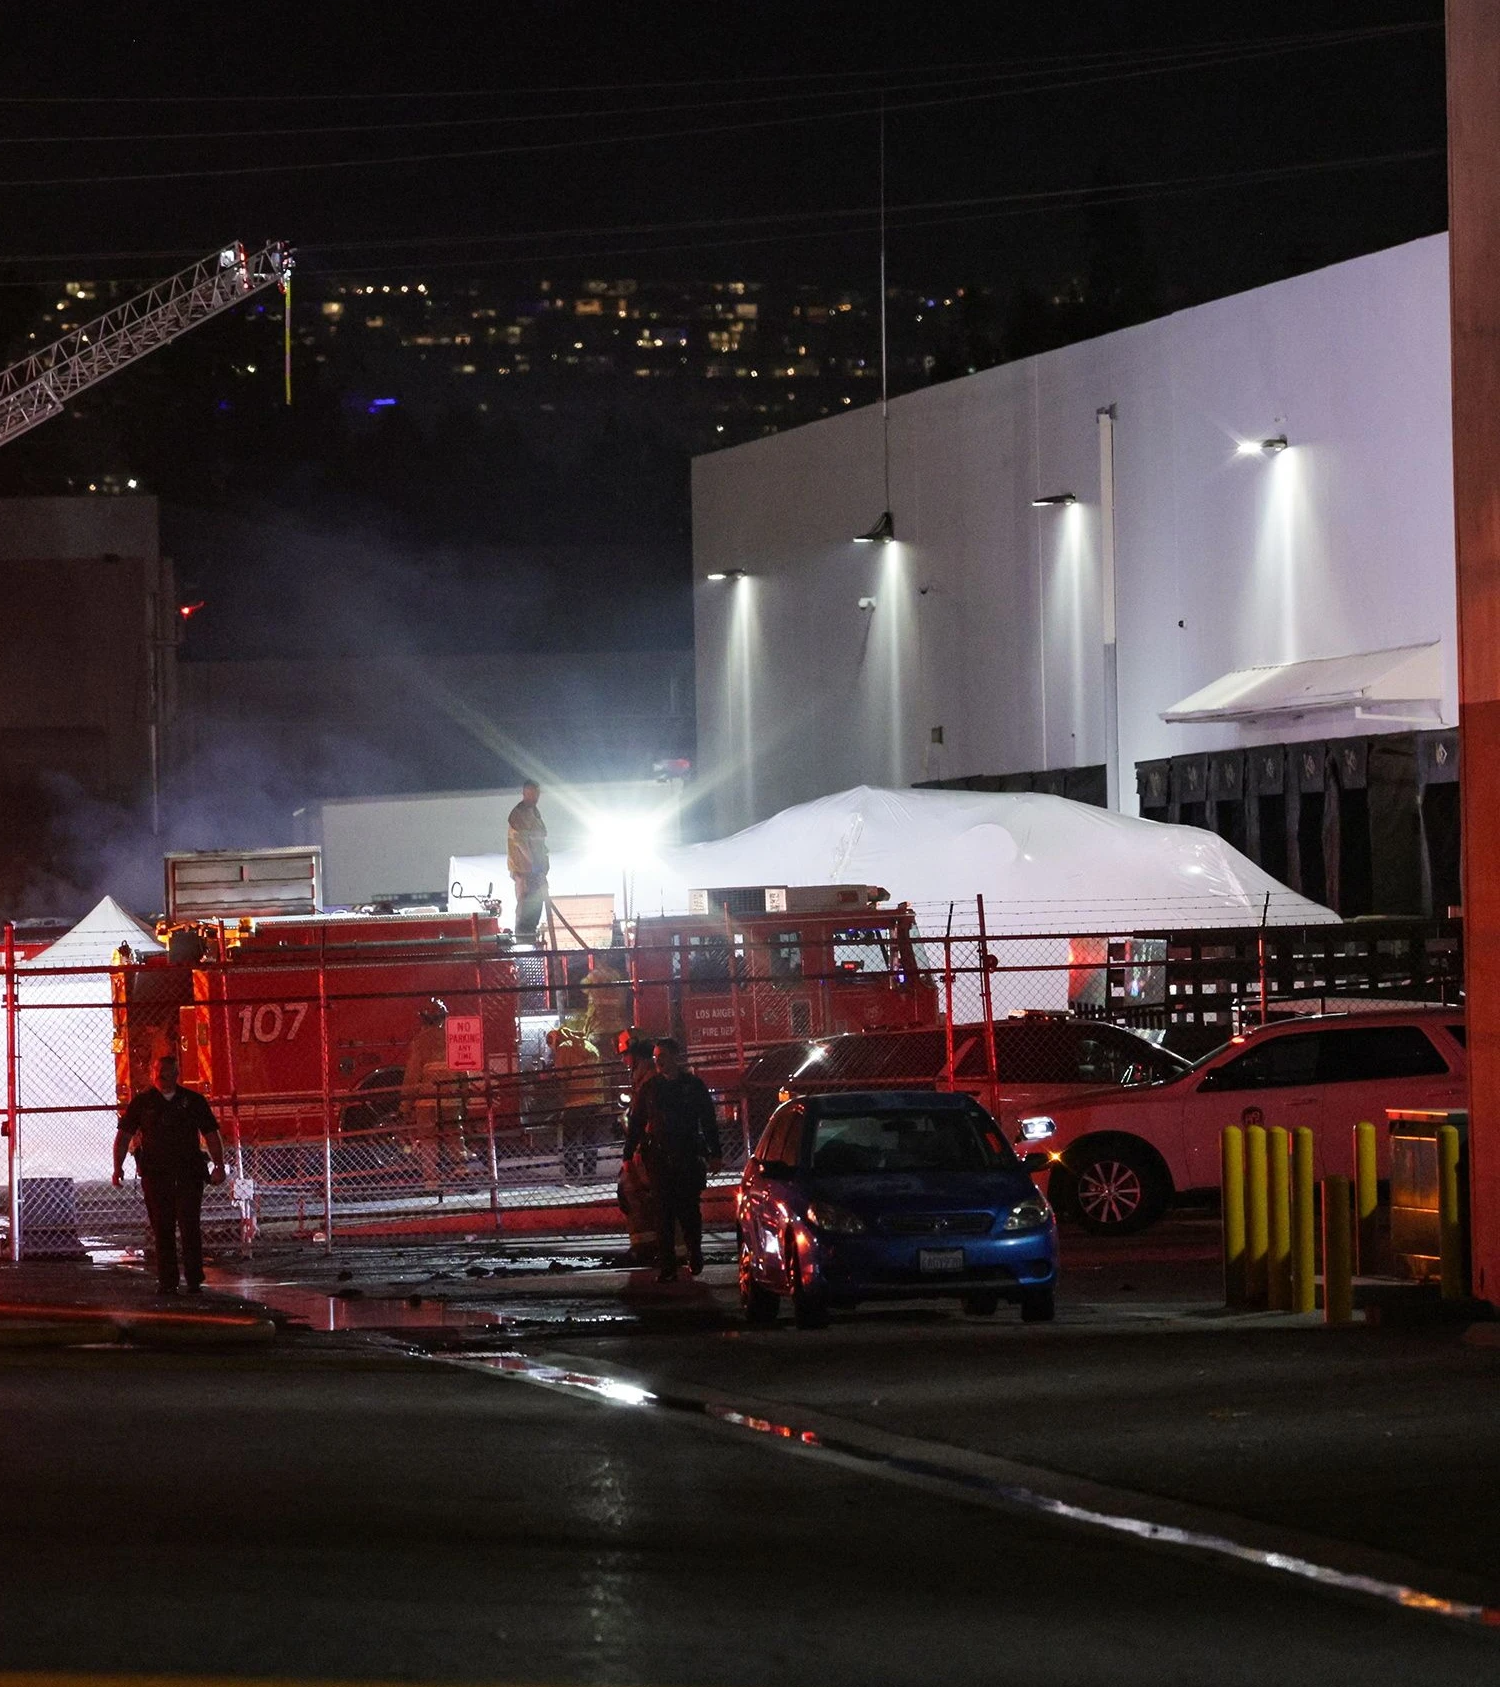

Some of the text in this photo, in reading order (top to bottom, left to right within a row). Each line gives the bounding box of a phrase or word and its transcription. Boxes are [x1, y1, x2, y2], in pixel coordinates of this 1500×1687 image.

[695, 1007, 746, 1019] LOS ANGELS
[239, 1002, 308, 1042] 107
[457, 1021, 471, 1032] NO
[702, 1025, 736, 1037] FIRE DEP
[449, 1034, 481, 1044] PARKING
